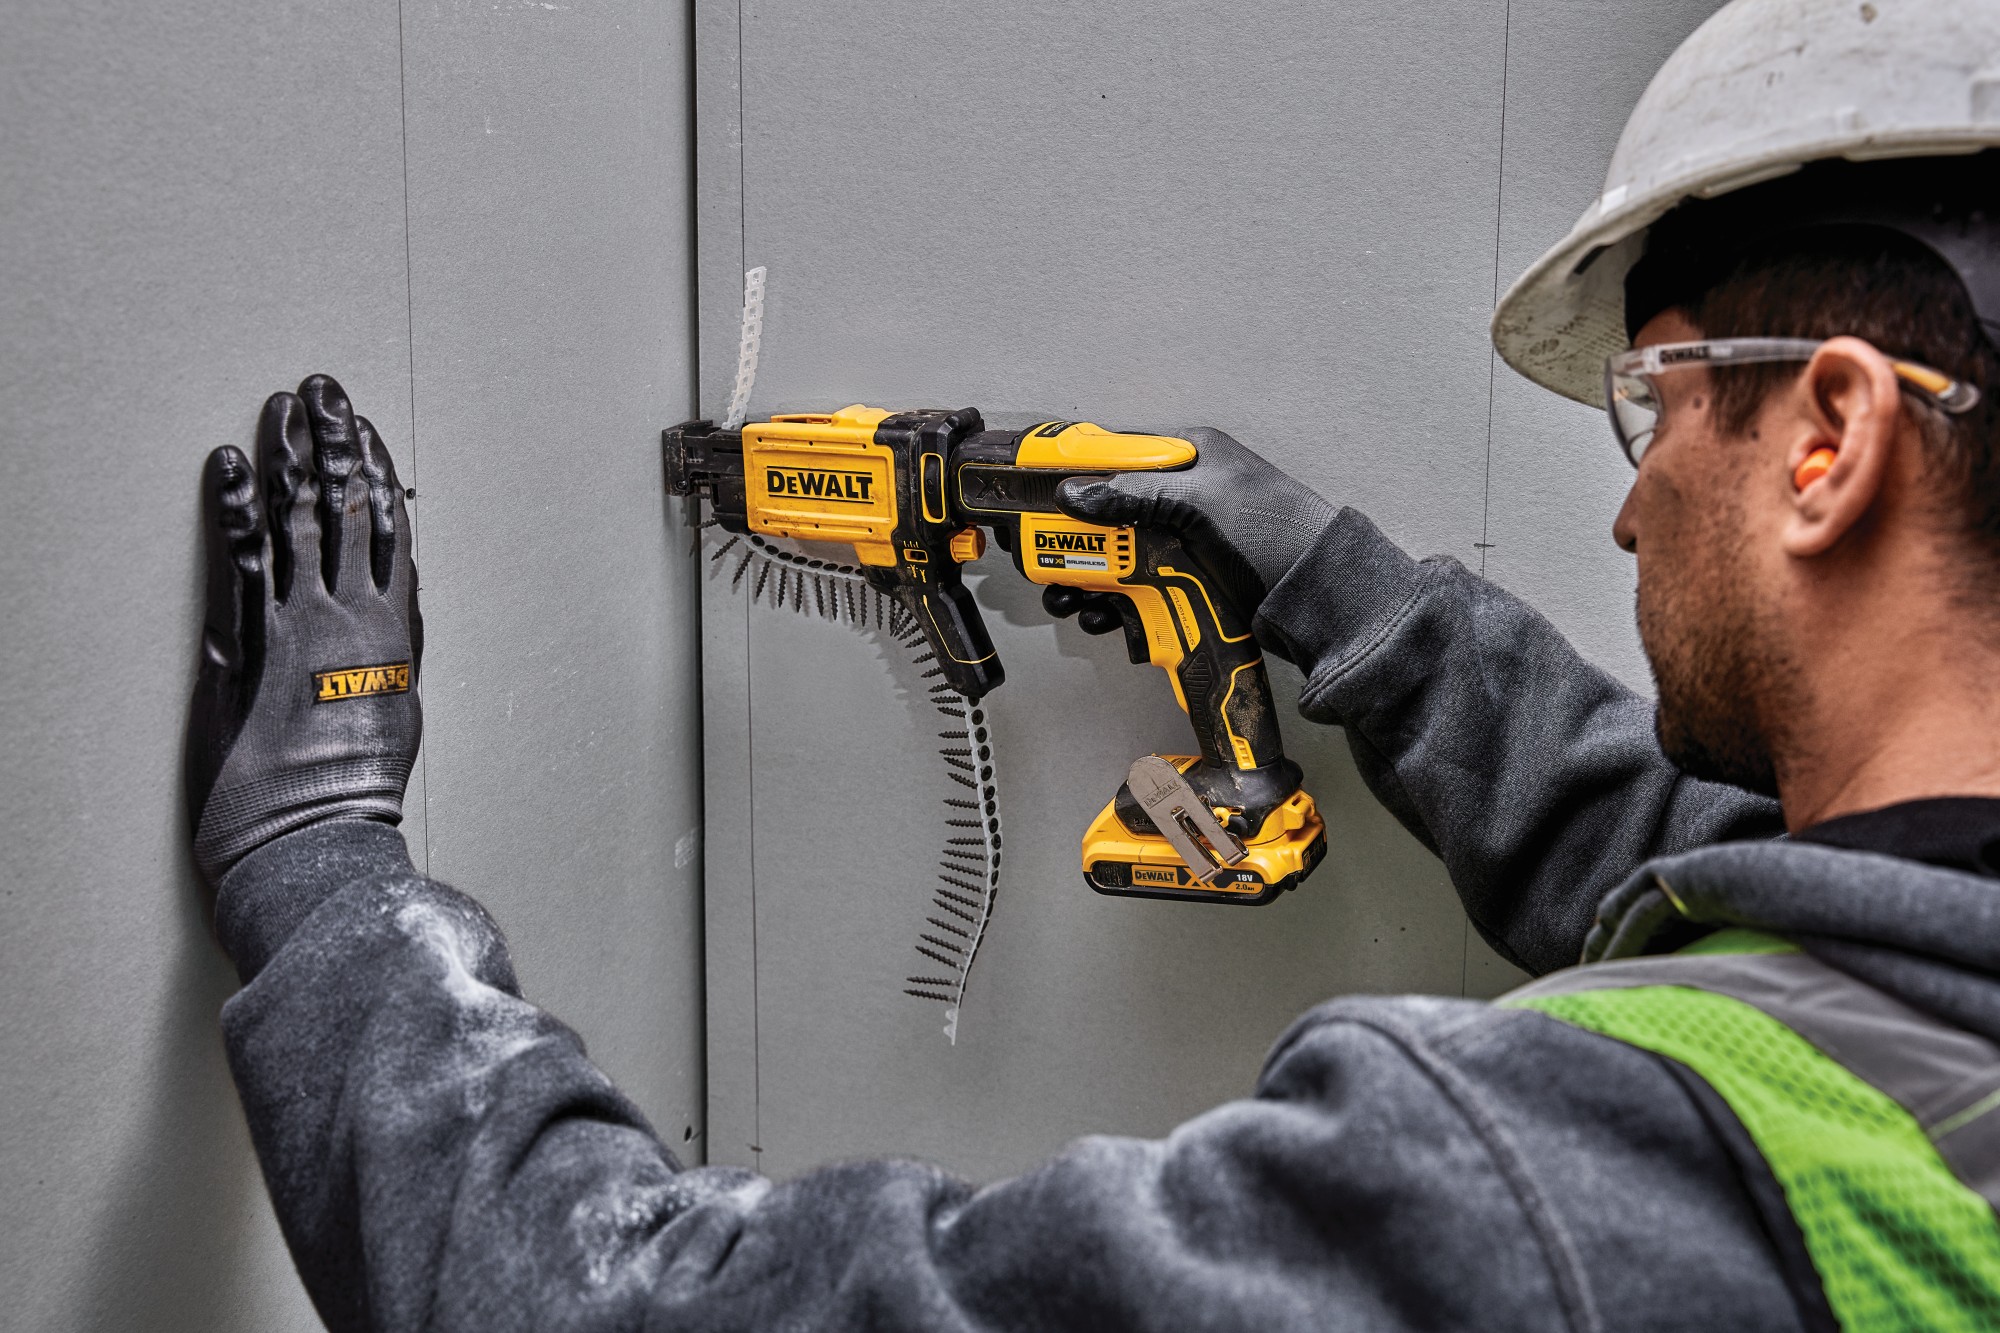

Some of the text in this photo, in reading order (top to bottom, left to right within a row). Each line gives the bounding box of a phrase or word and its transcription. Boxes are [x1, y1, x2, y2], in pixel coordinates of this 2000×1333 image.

[767, 470, 873, 499] DEWALT
[1035, 534, 1106, 551] DEWALT
[319, 667, 409, 697] DEWALT
[1135, 870, 1174, 882] DEWALT
[1236, 873, 1253, 882] 18V
